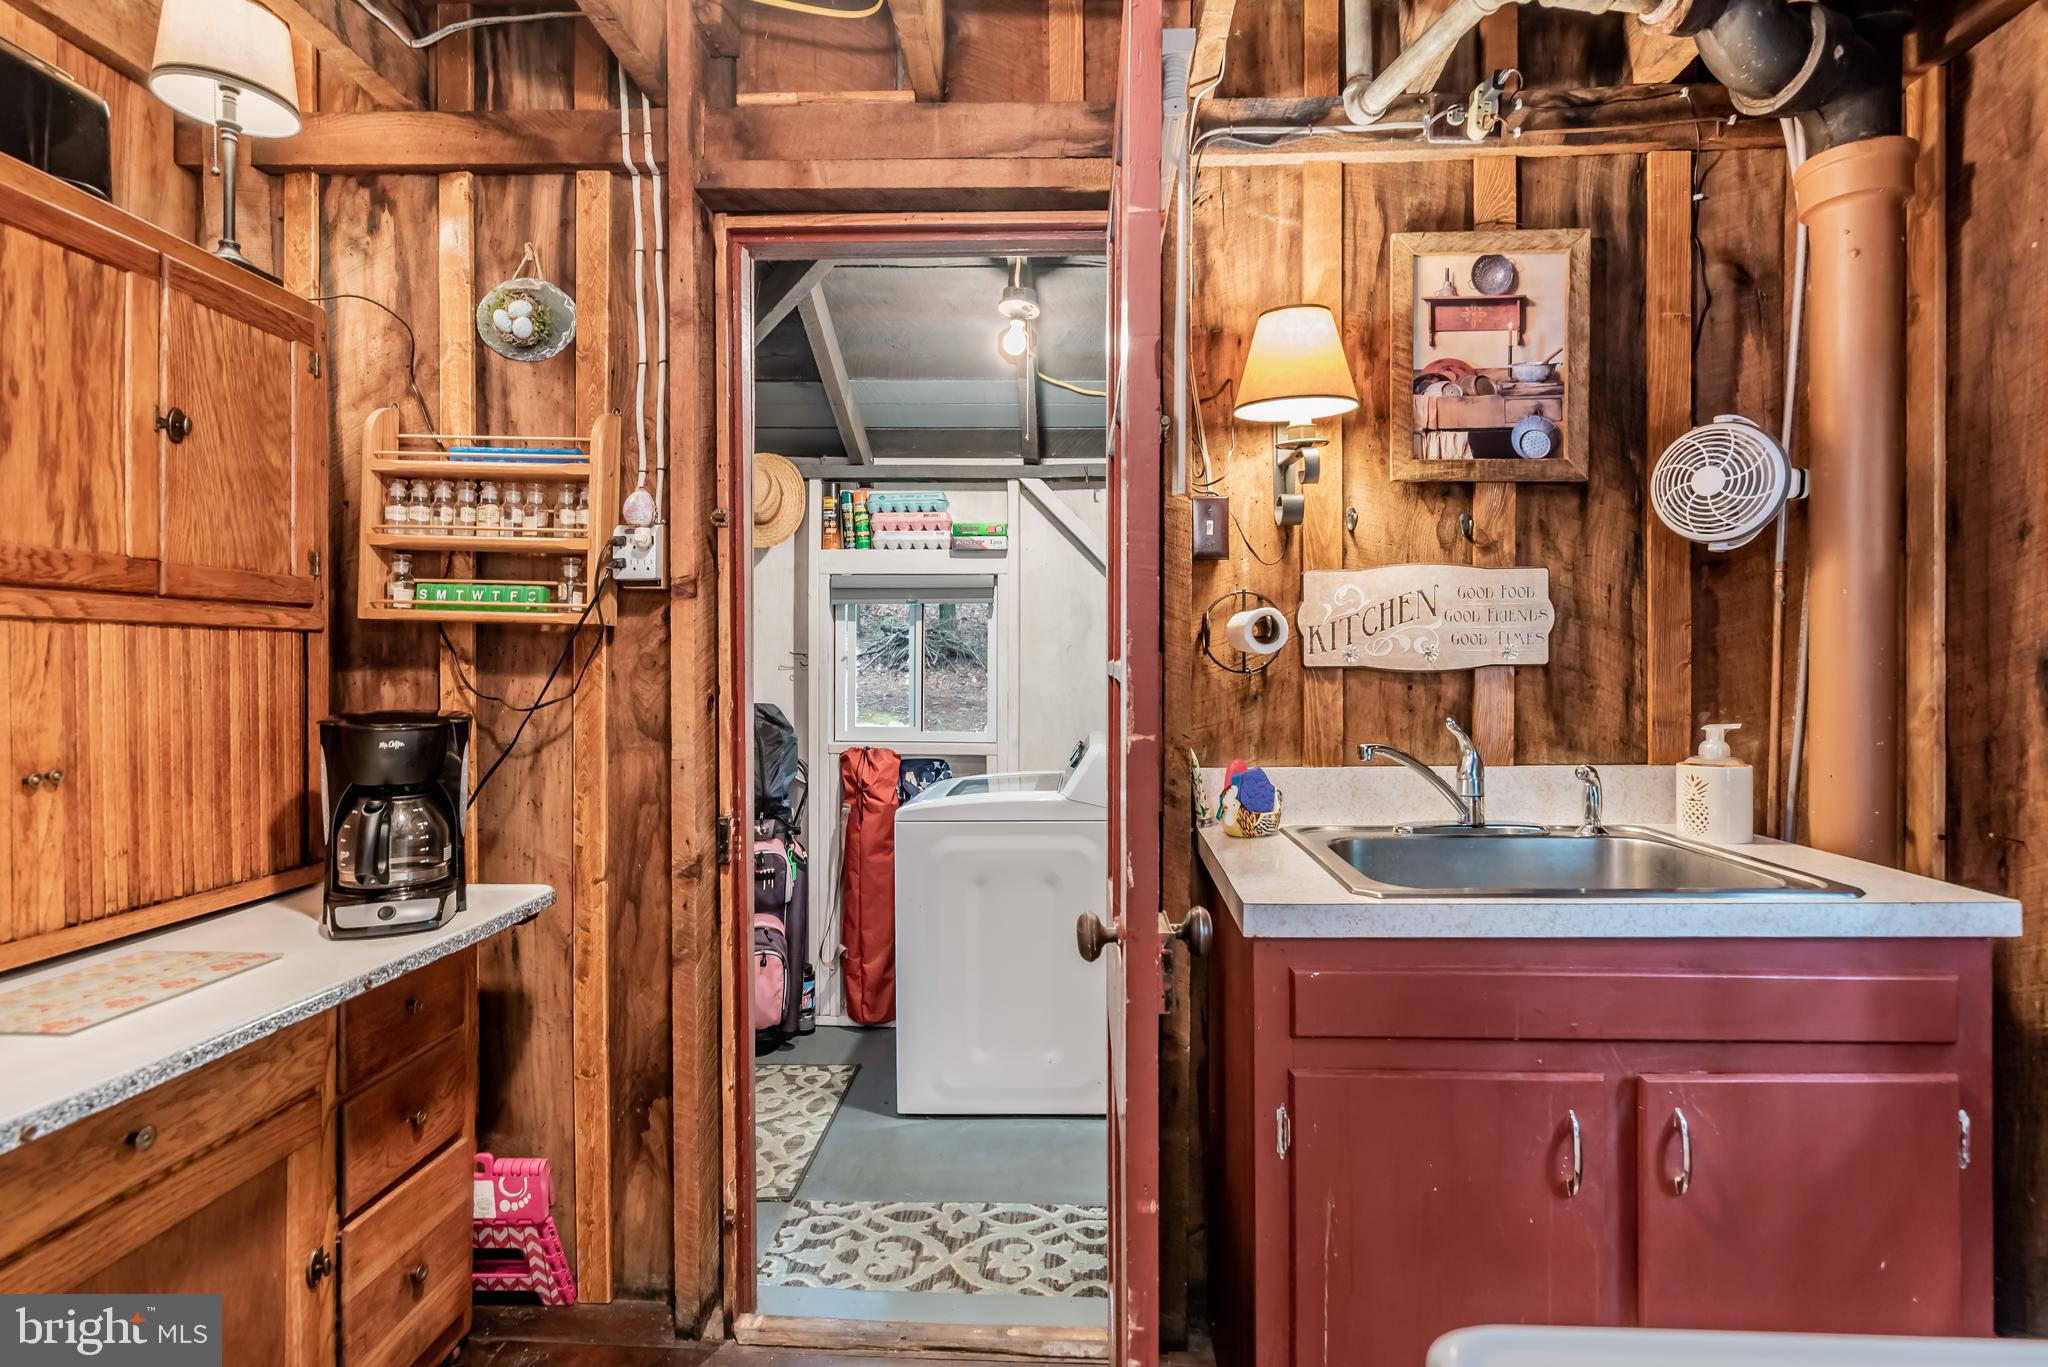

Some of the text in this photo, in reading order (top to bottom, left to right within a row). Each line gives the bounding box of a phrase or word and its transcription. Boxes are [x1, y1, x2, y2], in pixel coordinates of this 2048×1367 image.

[419, 589, 428, 599] S
[436, 590, 447, 600] M
[456, 590, 464, 600] T
[472, 590, 484, 600] W
[492, 591, 500, 600] T
[510, 591, 518, 601] F
[1457, 584, 1535, 600] GOOD FOOD
[1307, 584, 1439, 655] KITCHEN
[1444, 607, 1548, 623] GOOD FRIENDS
[1451, 630, 1545, 646] GOOD TIMES
